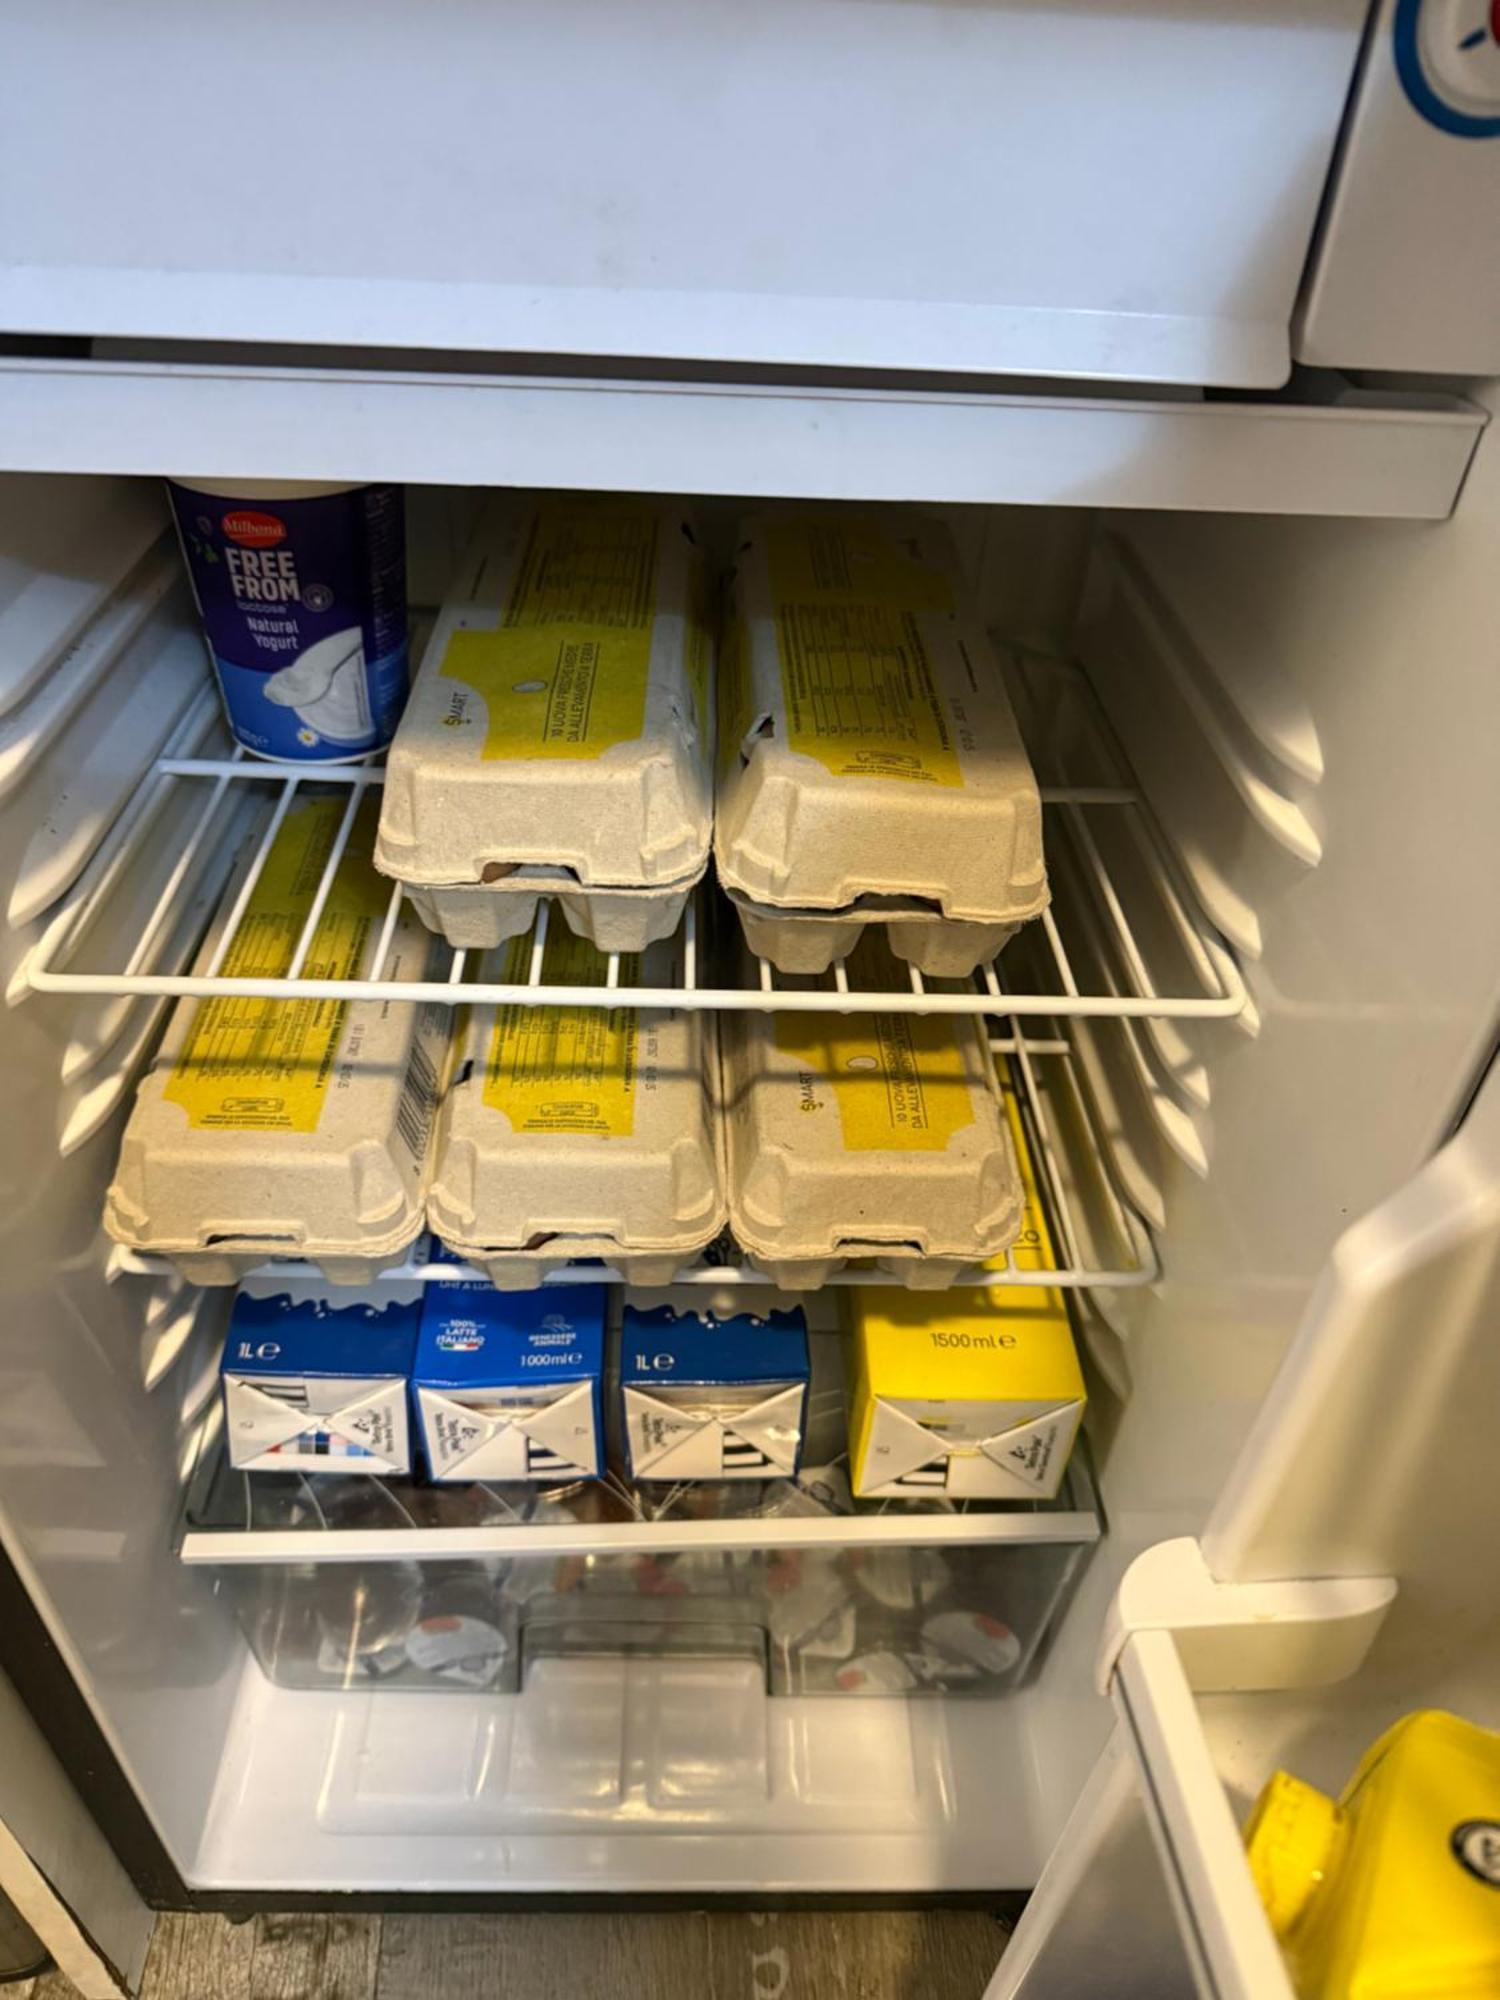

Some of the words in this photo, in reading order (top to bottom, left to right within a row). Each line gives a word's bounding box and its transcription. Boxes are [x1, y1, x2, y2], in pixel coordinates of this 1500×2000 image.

[225, 547, 297, 578] FREE
[231, 574, 300, 601] FROM
[247, 616, 299, 633] Natural
[252, 633, 298, 652] Yogurt
[799, 1071, 817, 1112] SMART
[911, 1114, 923, 1129] DA
[445, 1328, 478, 1336] LATTE
